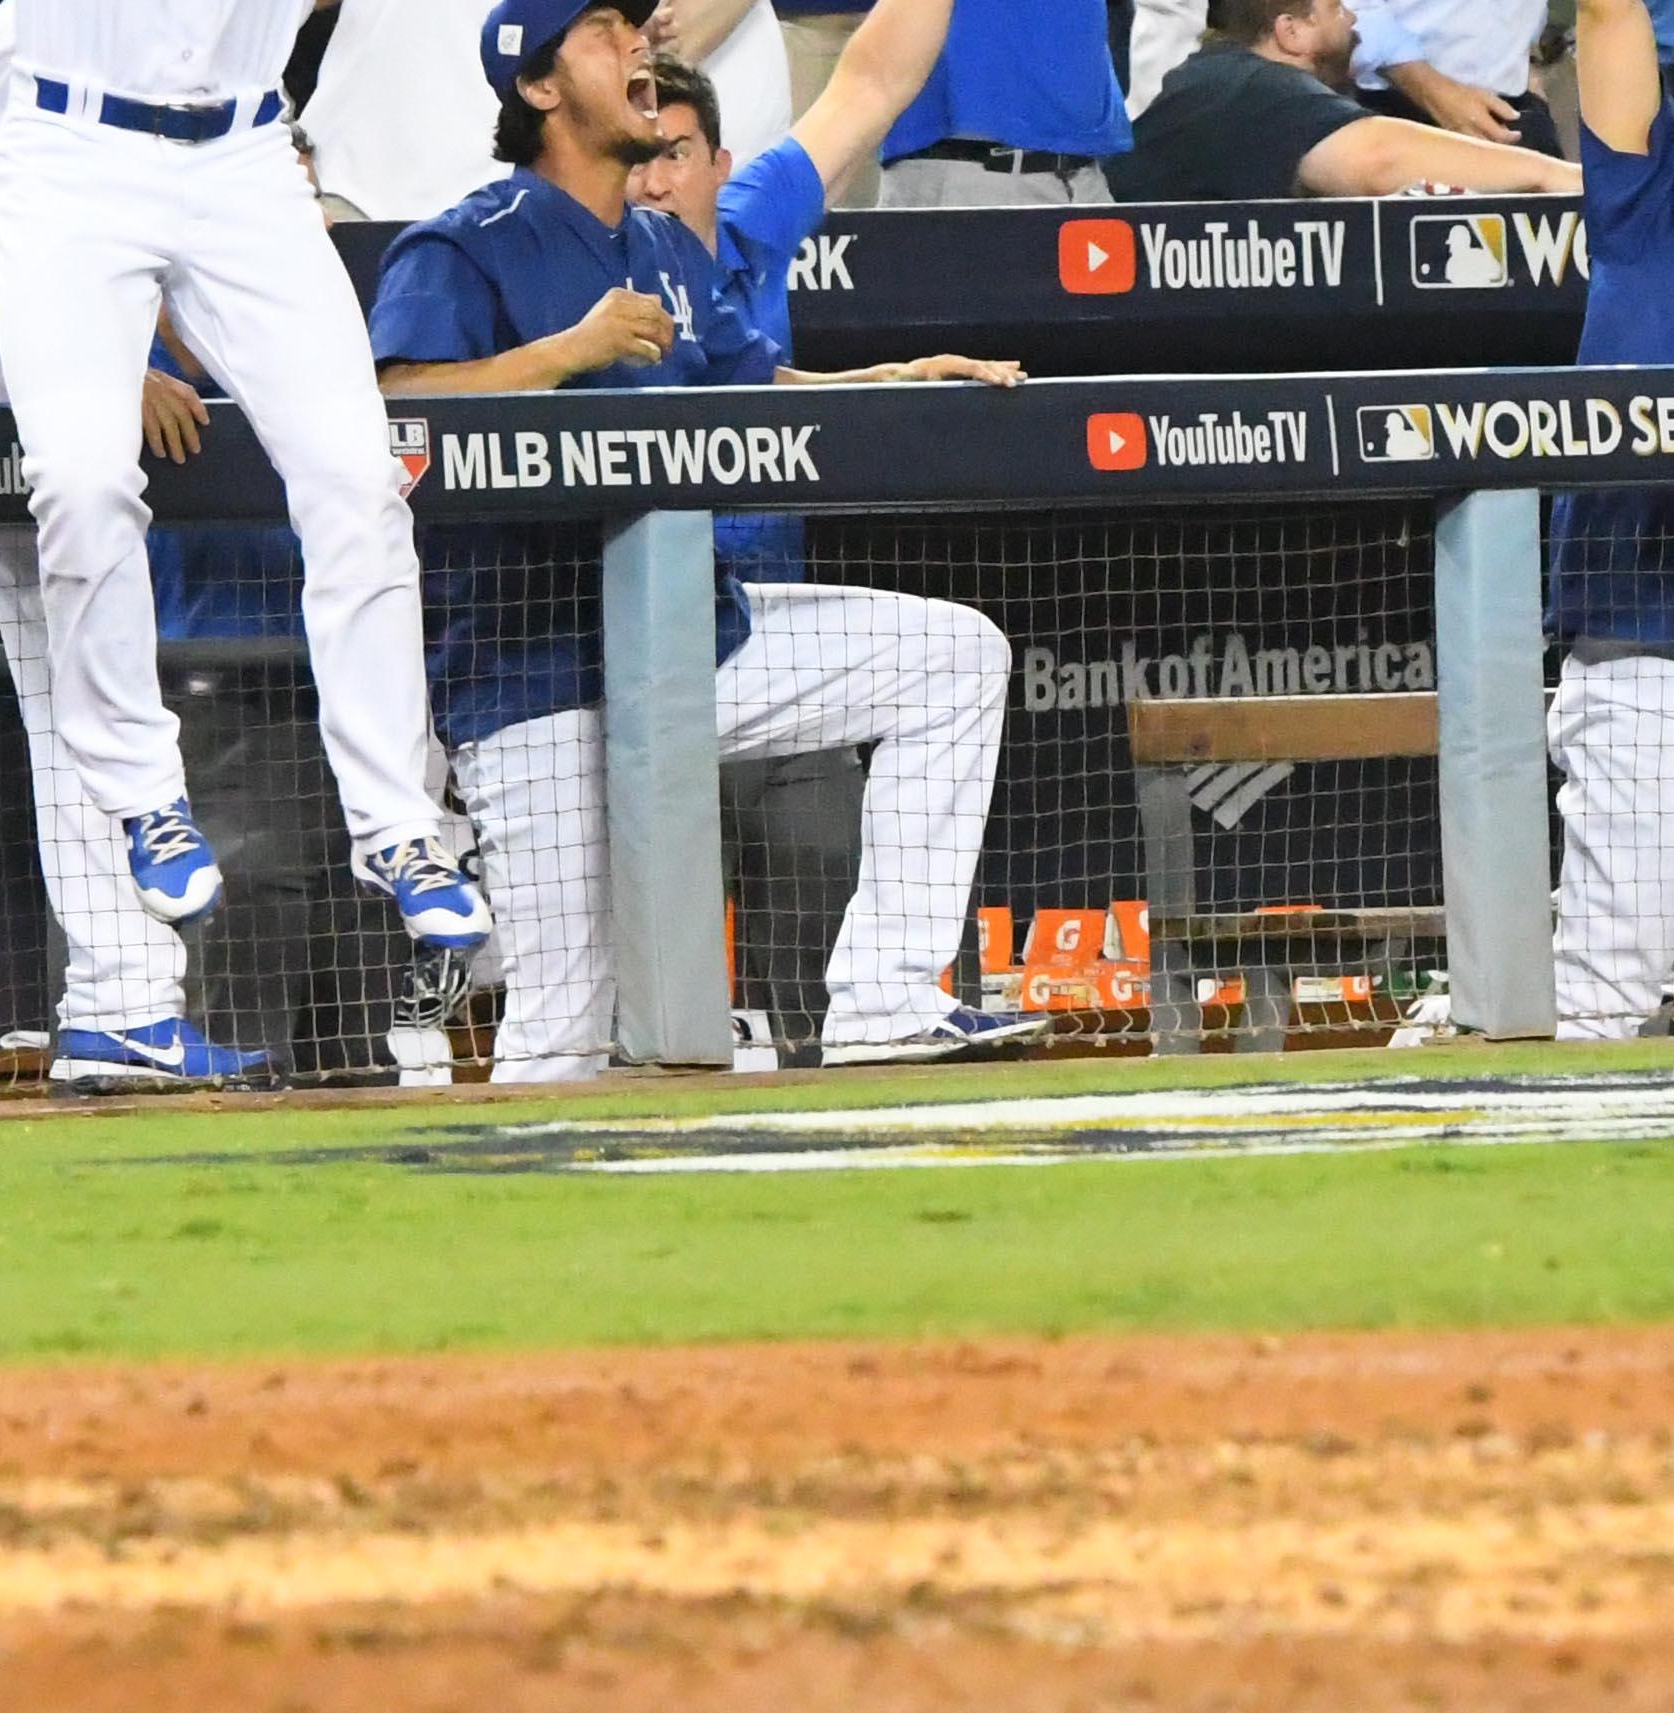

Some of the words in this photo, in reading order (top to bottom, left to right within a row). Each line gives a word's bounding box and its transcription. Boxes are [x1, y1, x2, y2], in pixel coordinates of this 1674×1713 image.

[442, 431, 552, 489] MLB
[560, 424, 821, 487] NETWORK
[1434, 397, 1622, 460] WORLD
[1025, 638, 1152, 712] Bank
[1158, 632, 1214, 699] of
[1219, 628, 1438, 696] America
